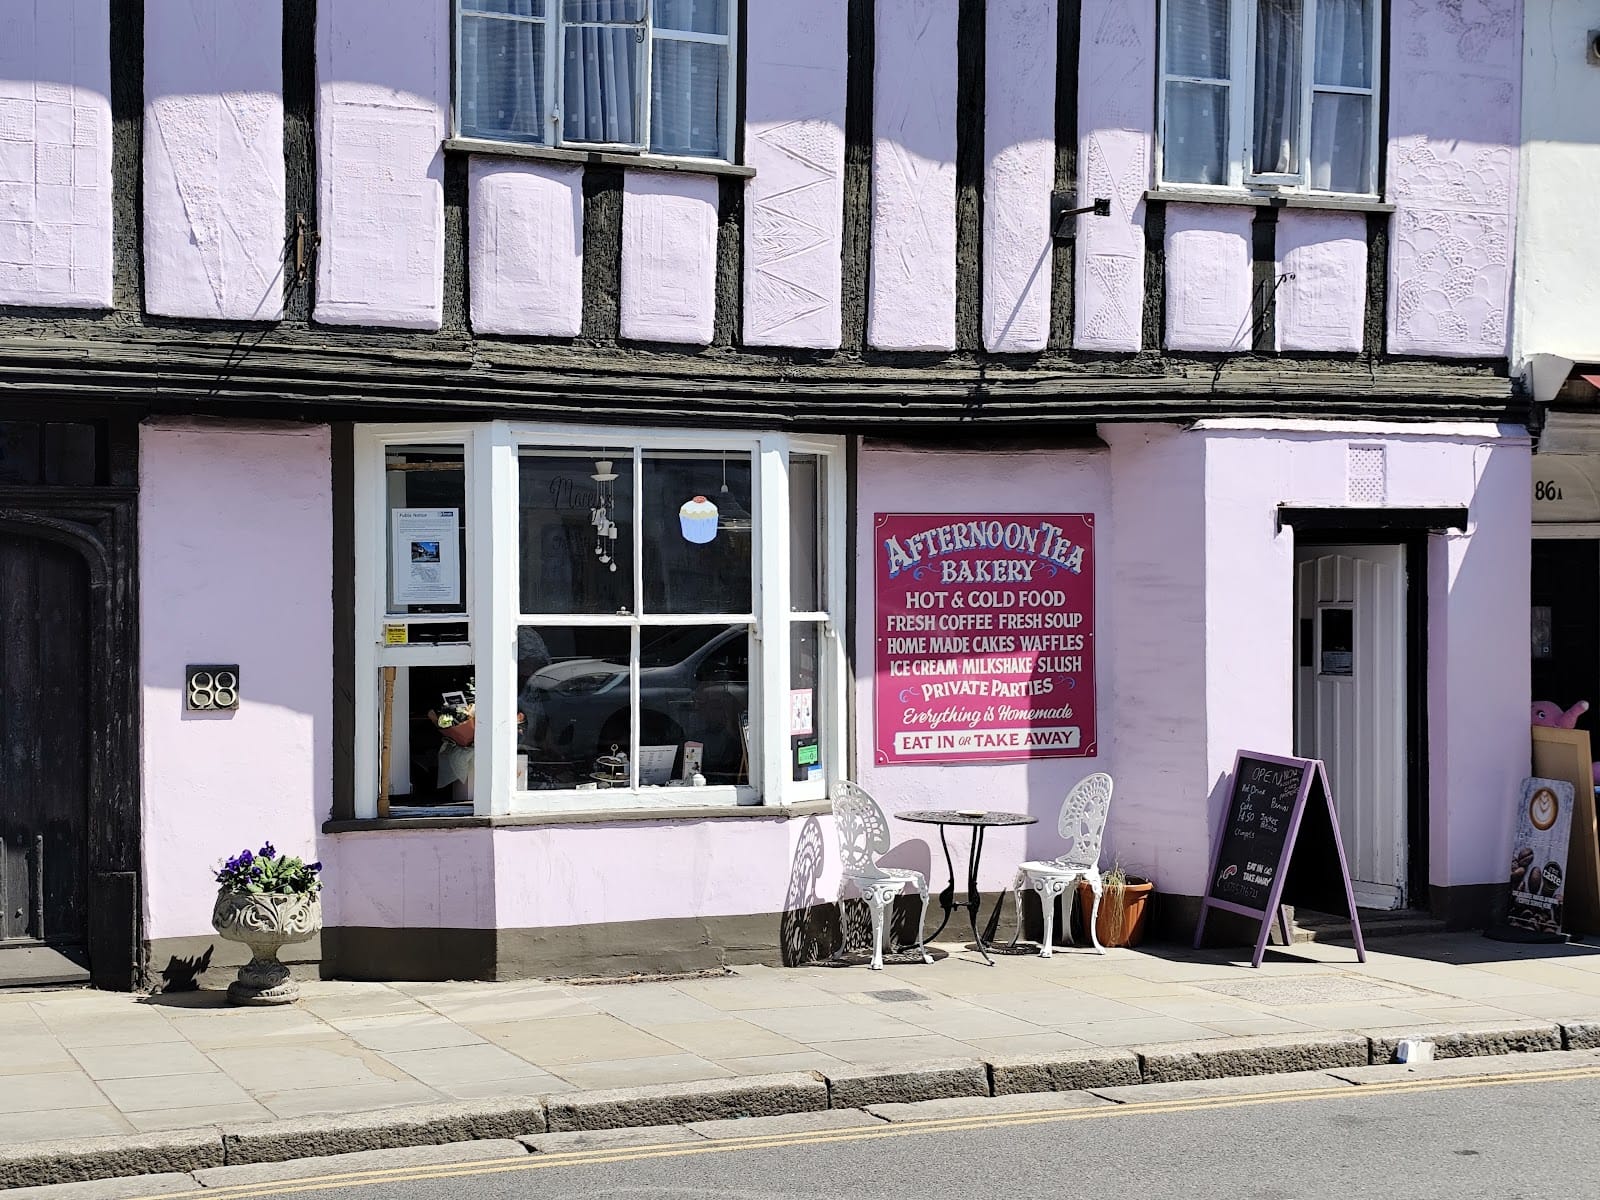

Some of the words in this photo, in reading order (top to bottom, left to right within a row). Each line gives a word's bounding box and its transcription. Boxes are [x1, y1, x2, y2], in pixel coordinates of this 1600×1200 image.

[886, 521, 1040, 577] AFTERNOON
[1039, 522, 1085, 574] TEA
[940, 560, 1037, 583] BAKERY
[906, 591, 948, 609] HOT
[951, 591, 964, 608] &
[968, 591, 1015, 608] COLD
[1019, 590, 1066, 607] FOOD
[887, 615, 936, 631] FRESH
[939, 614, 993, 630] COFFEE
[999, 614, 1042, 629] FRESH
[1045, 613, 1083, 628] SOUP
[887, 637, 926, 654] HOME
[929, 637, 970, 654] MADE
[973, 636, 1015, 653] CAKES
[1019, 635, 1084, 651] WAFFLES
[890, 660, 910, 677] ICE
[912, 659, 958, 676] CREAM
[962, 657, 1033, 675] MILKSHAKE
[1037, 656, 1082, 673] SLUSH
[191, 671, 236, 706] 88
[921, 680, 989, 702] PRIVATE
[991, 678, 1054, 697] PARTIES
[902, 705, 981, 729] Everything
[983, 706, 995, 721] is
[998, 704, 1073, 721] Homemade
[903, 736, 933, 750] EAT
[938, 735, 955, 749] IN
[958, 735, 972, 746] OR
[974, 733, 1020, 747] TAKE
[1024, 731, 1073, 746] AWAY
[1252, 767, 1283, 786] OPEN
